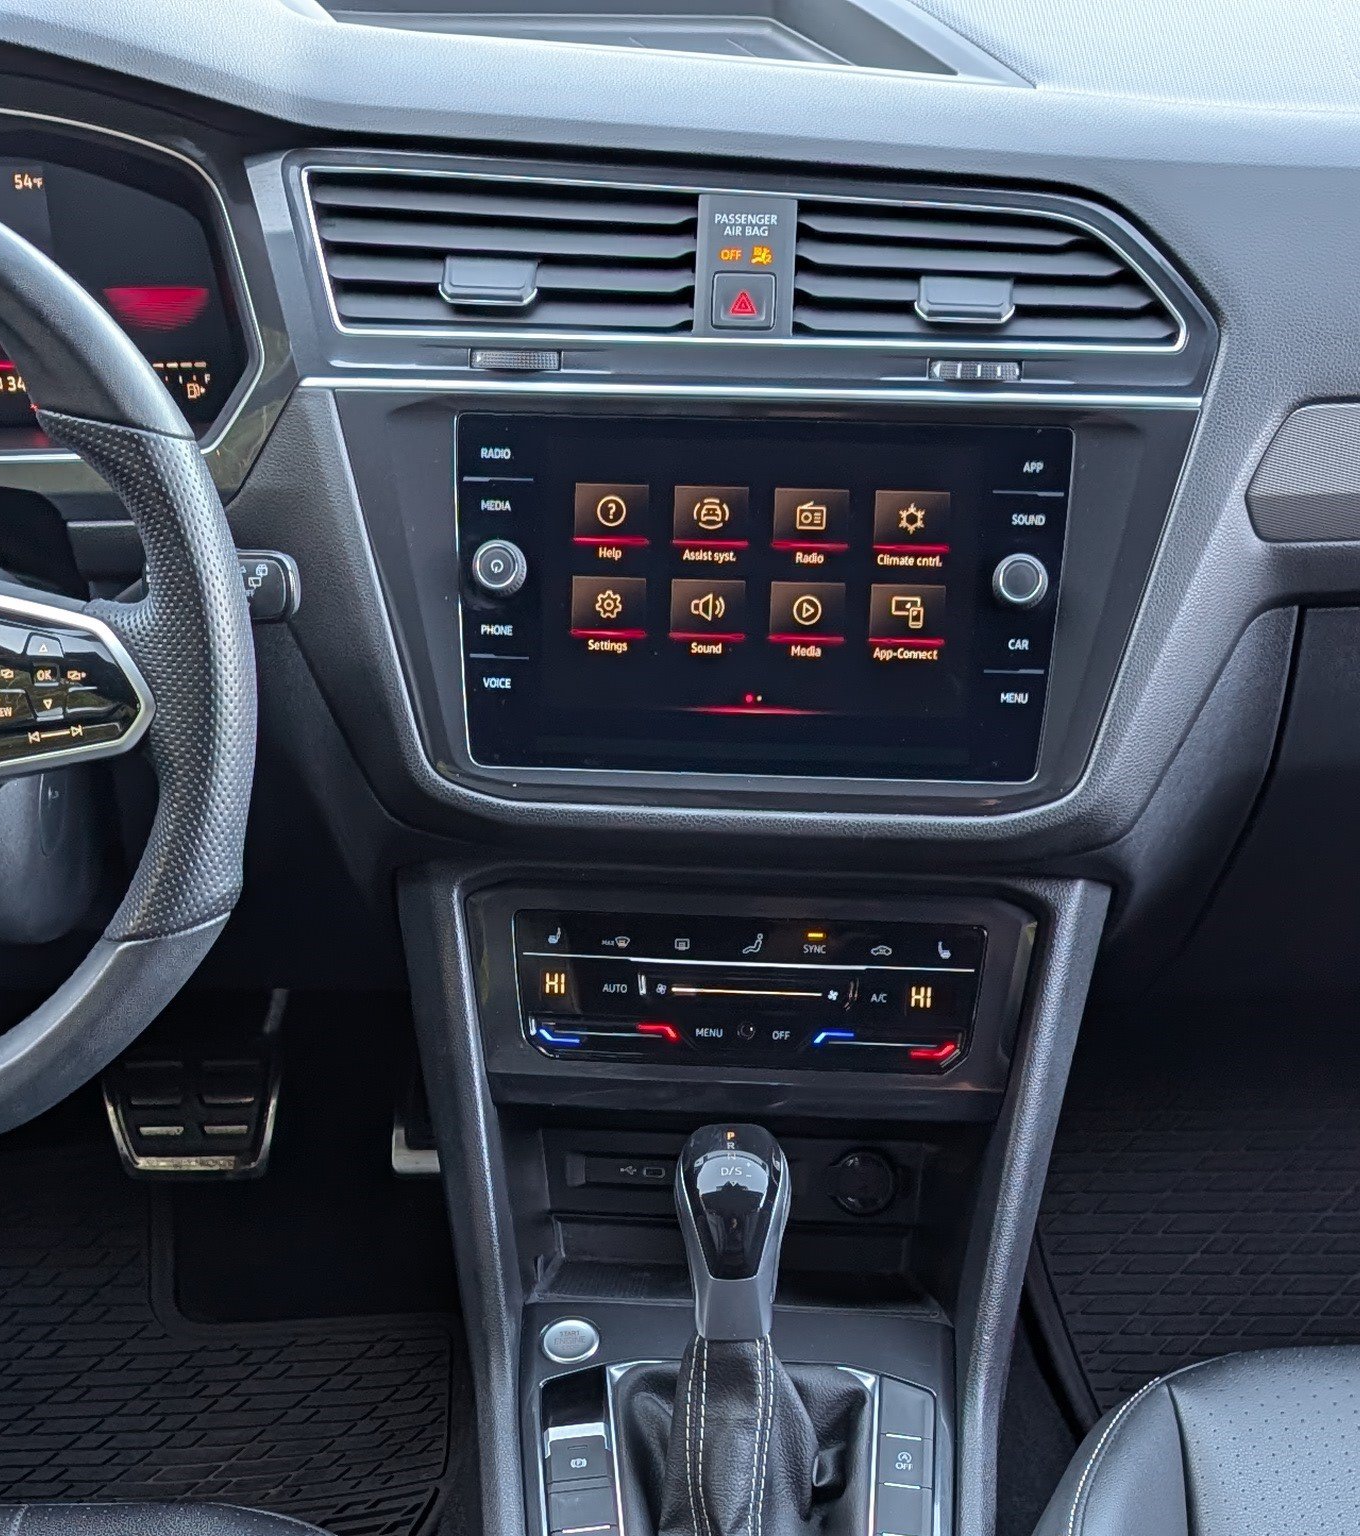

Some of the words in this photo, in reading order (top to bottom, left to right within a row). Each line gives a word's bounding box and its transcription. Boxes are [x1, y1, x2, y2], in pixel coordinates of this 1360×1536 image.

[714, 213, 778, 226] PASSENGER
[723, 226, 742, 236] AIR
[745, 226, 769, 237] BAG
[721, 249, 742, 260] OFF
[480, 447, 511, 459] RADIO
[1023, 461, 1044, 473] APP
[480, 499, 512, 512] MEDIA
[1011, 513, 1046, 526] SOUND
[598, 547, 622, 561] Help
[682, 549, 712, 561] Assist
[713, 550, 737, 563] syst.
[795, 551, 824, 564] Radio
[877, 554, 914, 567] Climate
[916, 555, 943, 568] cntrl.
[480, 624, 513, 636] PHONE
[587, 639, 628, 654] Settings
[691, 642, 722, 655] Sound
[1008, 638, 1029, 650] CAR
[790, 645, 822, 658] Media
[873, 647, 938, 661] App-Connect
[36, 669, 52, 681] OK
[482, 677, 512, 689] VOICE
[1000, 692, 1029, 704] MENU
[803, 944, 827, 955] SYNC
[545, 972, 566, 994] HI
[602, 983, 628, 994] AUTO
[870, 993, 888, 1004] A/C
[910, 986, 932, 1008] HI
[695, 1028, 724, 1038] MENU
[772, 1030, 791, 1041] OFF
[726, 1131, 736, 1140] P
[726, 1142, 736, 1150] R
[720, 1166, 743, 1176] D/S
[895, 1462, 913, 1471] OFF
